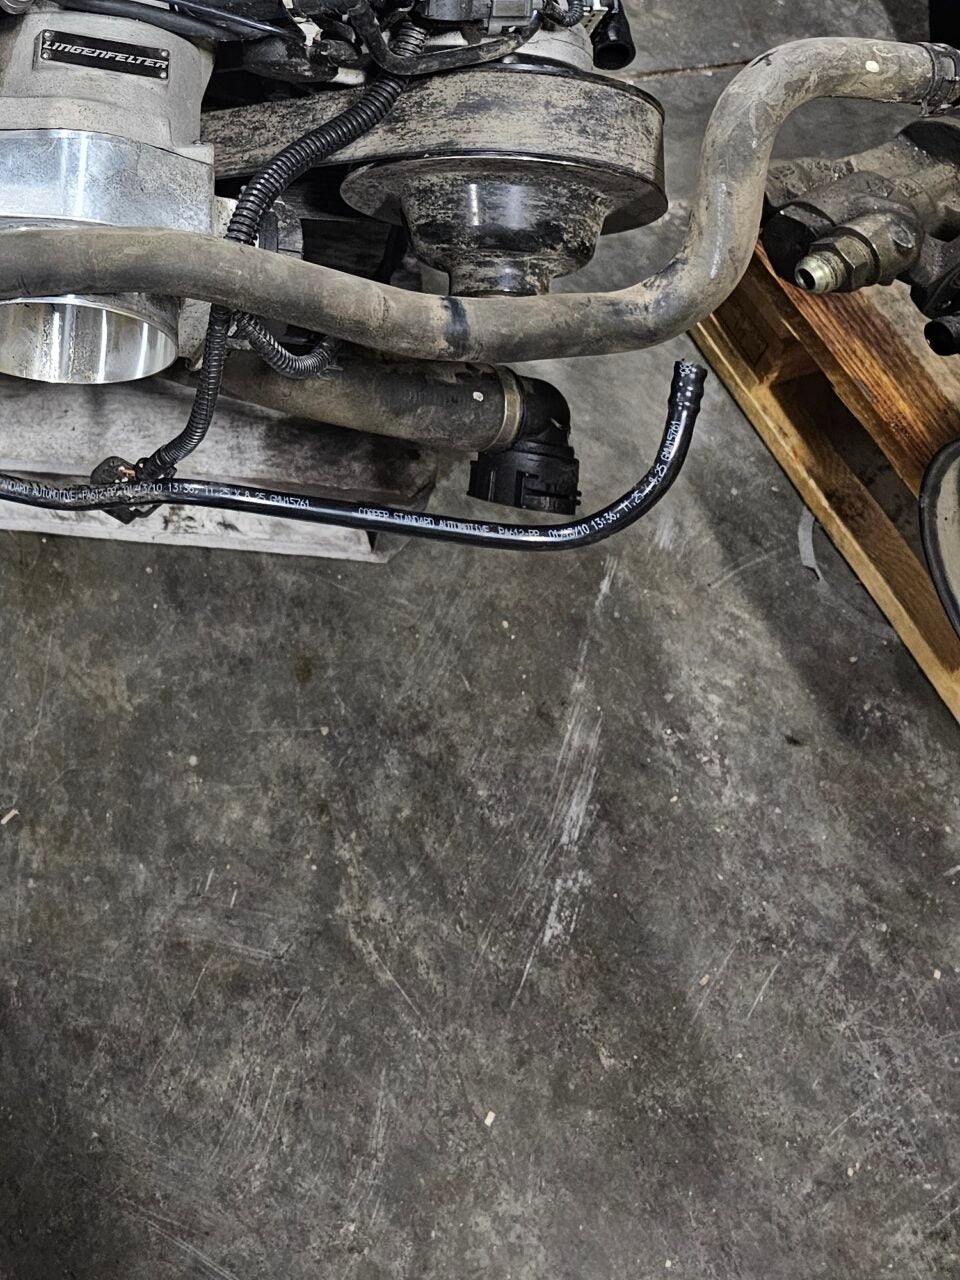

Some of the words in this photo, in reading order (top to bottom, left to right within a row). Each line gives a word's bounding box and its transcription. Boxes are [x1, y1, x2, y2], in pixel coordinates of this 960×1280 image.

[42, 41, 169, 69] LINGENFELTER
[205, 486, 231, 497] 11.25
[234, 489, 241, 498] X
[358, 507, 389, 520] COOPER
[393, 512, 435, 527] STANDARD
[623, 489, 644, 512] 11.25
